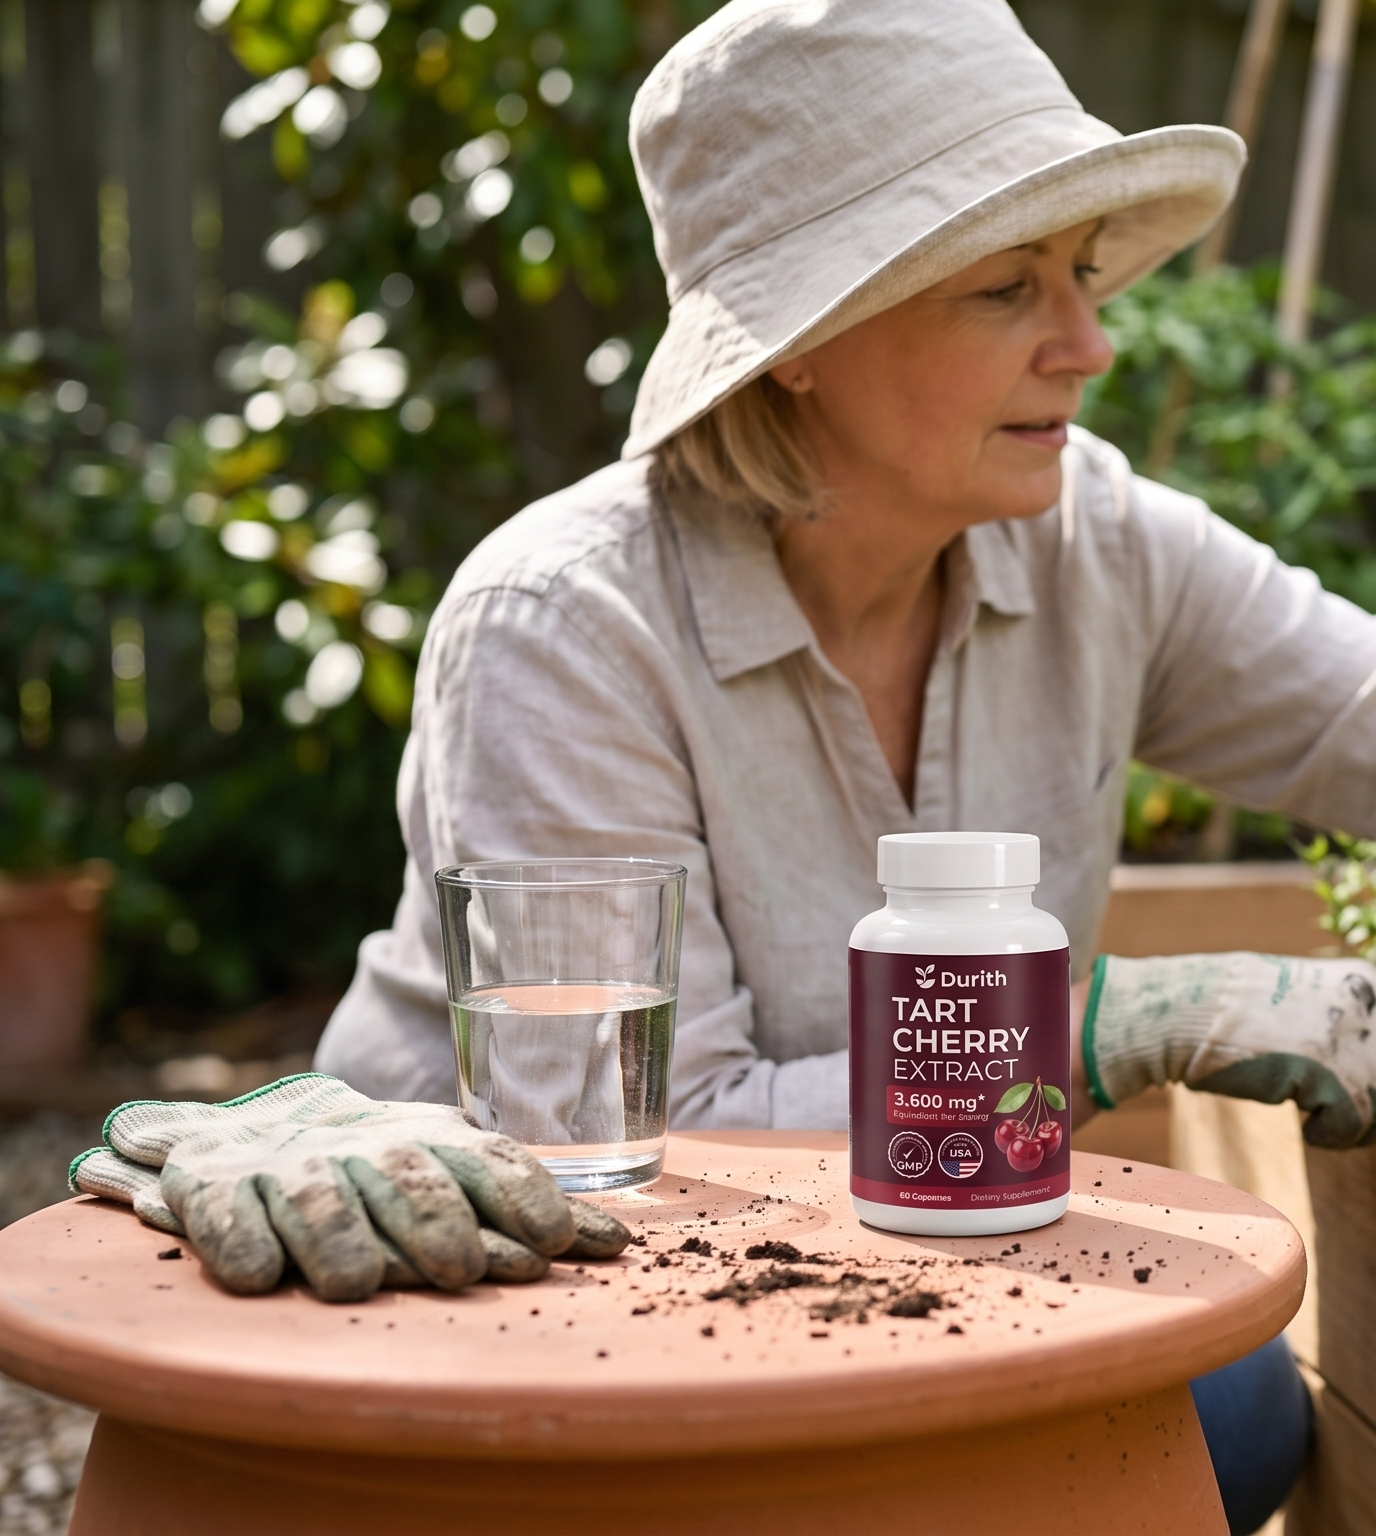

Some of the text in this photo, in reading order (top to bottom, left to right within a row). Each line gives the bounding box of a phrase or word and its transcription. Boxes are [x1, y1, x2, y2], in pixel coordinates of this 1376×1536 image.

[941, 970, 1007, 987] Durith
[891, 996, 978, 1023] TART
[892, 1026, 1030, 1054] CHERRY
[894, 1058, 1019, 1081] EXTRACT
[894, 1092, 943, 1109] 3.600
[949, 1149, 972, 1157] USA
[896, 1160, 923, 1171] GMP
[899, 1191, 911, 1200] 60
